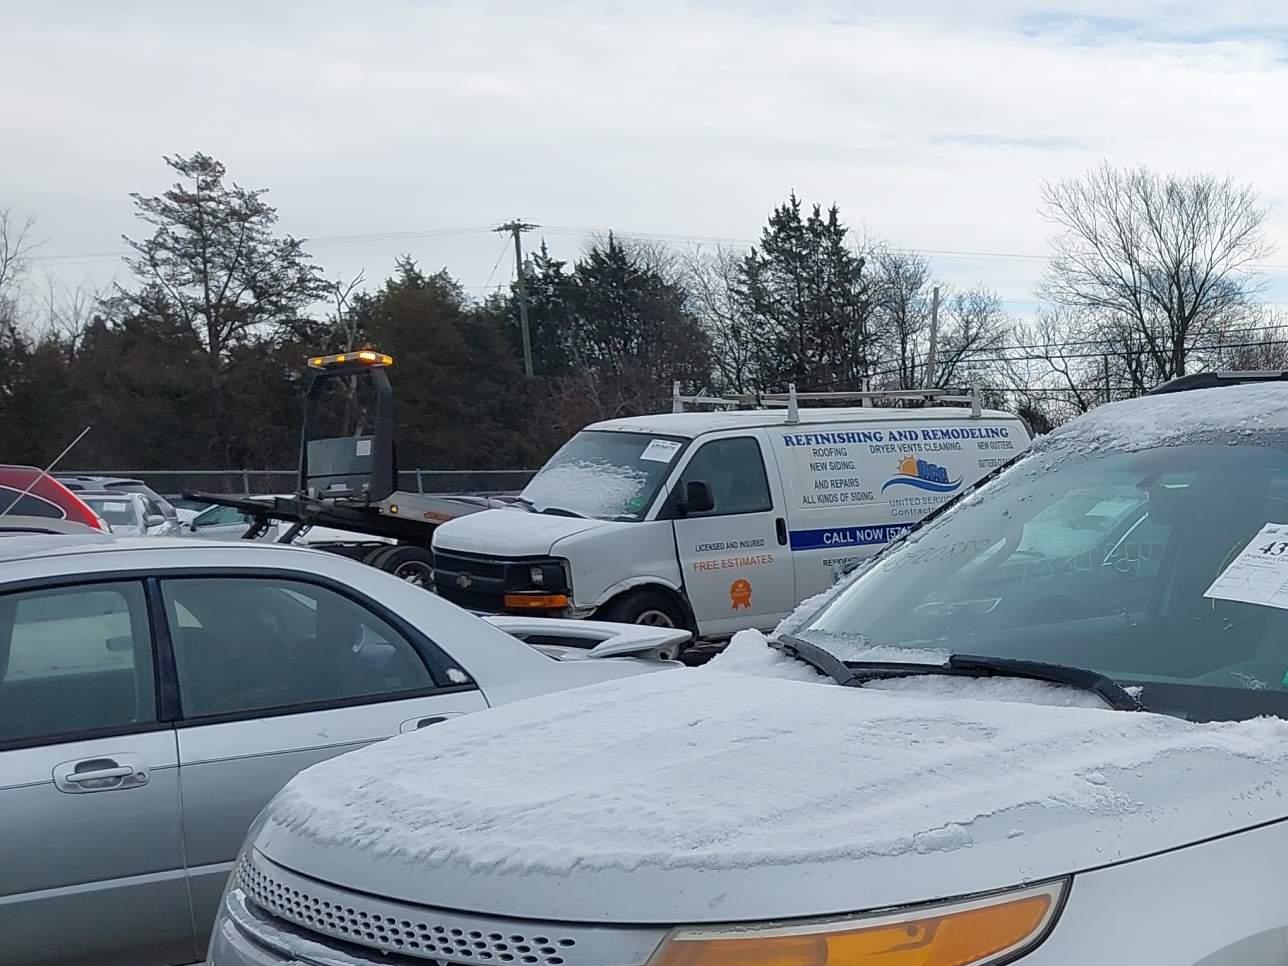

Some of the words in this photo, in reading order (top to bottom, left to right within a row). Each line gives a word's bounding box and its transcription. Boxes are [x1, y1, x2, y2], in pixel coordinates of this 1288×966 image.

[783, 431, 884, 447] REFINISHING
[888, 430, 919, 442] AND
[921, 427, 1010, 441] REMODELING
[812, 447, 848, 458] ROOFING
[869, 444, 897, 454] DRYER
[897, 442, 923, 453] VENTS
[809, 462, 828, 472] NEW
[814, 479, 829, 490] AND
[830, 478, 860, 489] REPAIRS
[802, 495, 817, 505] ALL
[817, 493, 839, 503] KINDS
[839, 493, 850, 502] OF
[823, 531, 854, 544] CALL
[856, 528, 883, 542] NOW
[695, 542, 725, 552] LICENSED
[726, 541, 738, 550] AND
[739, 539, 765, 548] INSURED
[693, 560, 720, 572] FREE
[721, 554, 774, 569] ESTIMATES
